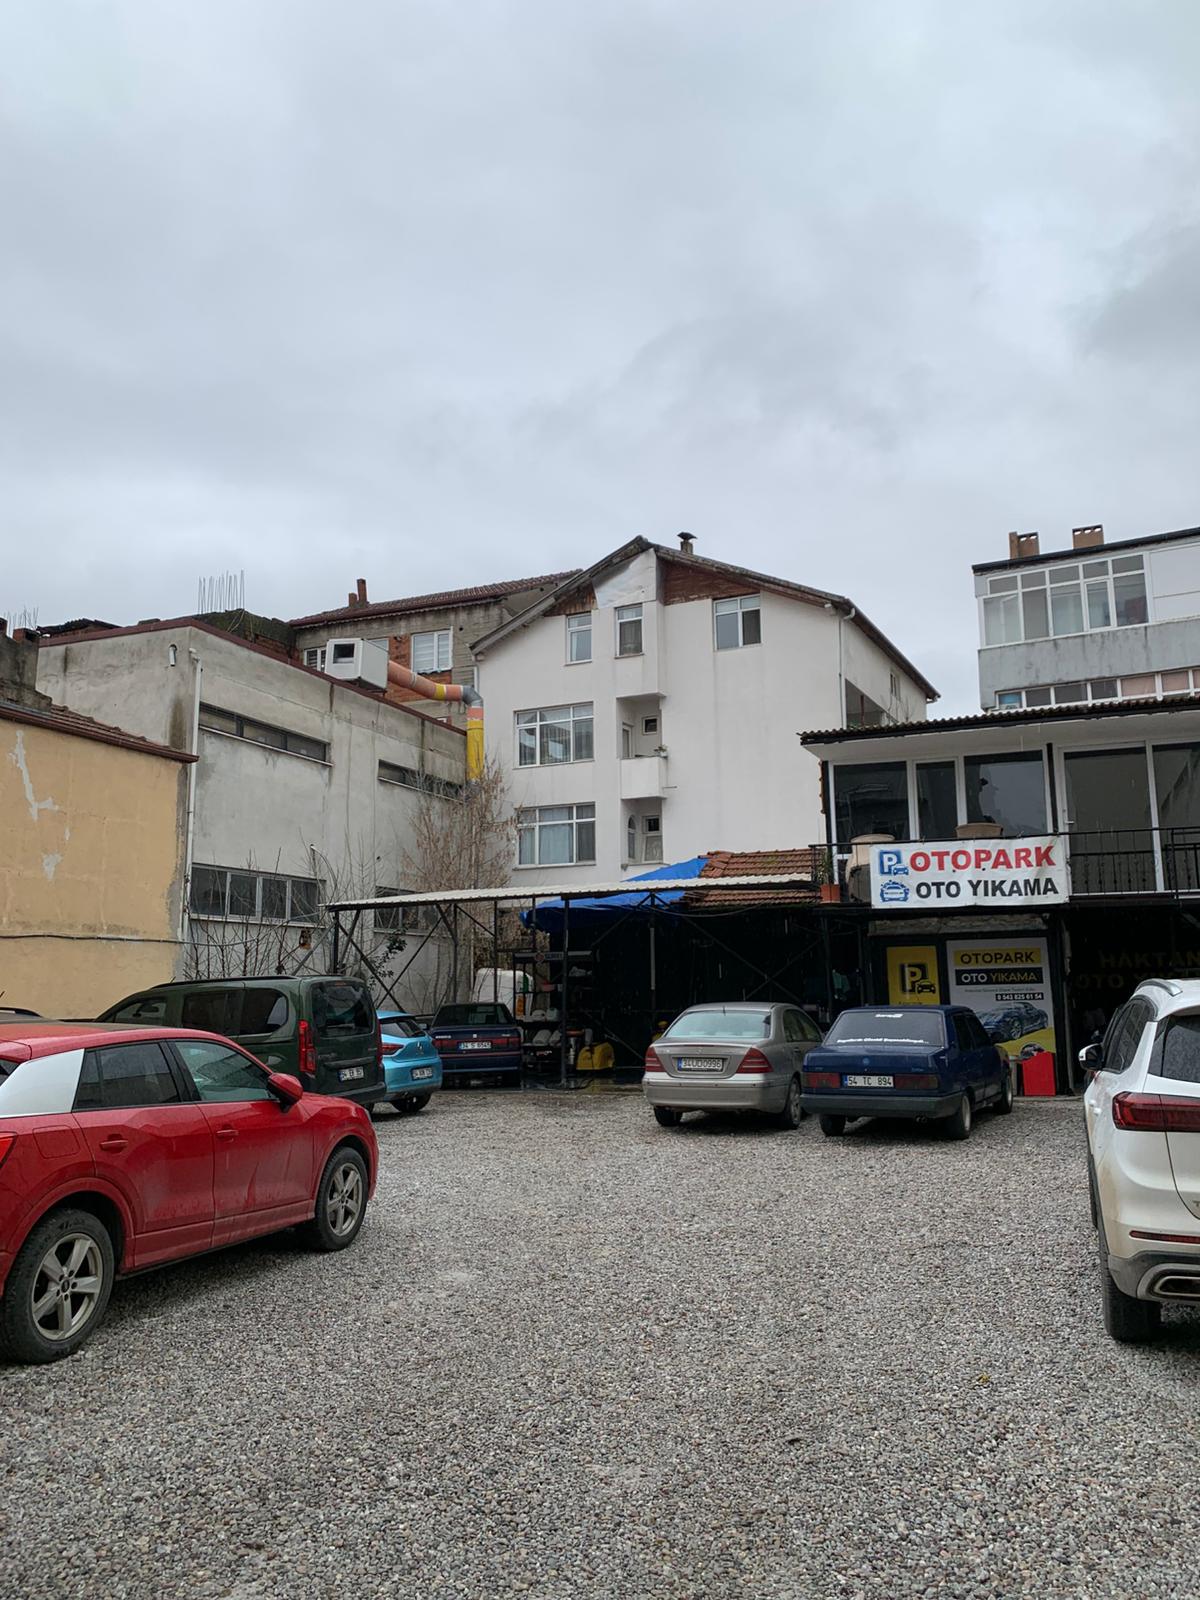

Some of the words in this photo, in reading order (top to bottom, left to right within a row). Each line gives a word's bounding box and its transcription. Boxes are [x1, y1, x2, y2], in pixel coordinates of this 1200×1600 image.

[910, 846, 1056, 872] OTOPARK
[915, 881, 961, 899] OTO
[968, 877, 1059, 897] YIKAMA
[960, 951, 1034, 964] OTOPARK
[961, 973, 988, 983] OTO
[990, 972, 1037, 983] YIKAMA
[848, 1077, 858, 1085] 54
[863, 1077, 872, 1085] TC
[878, 1077, 892, 1085] 894
